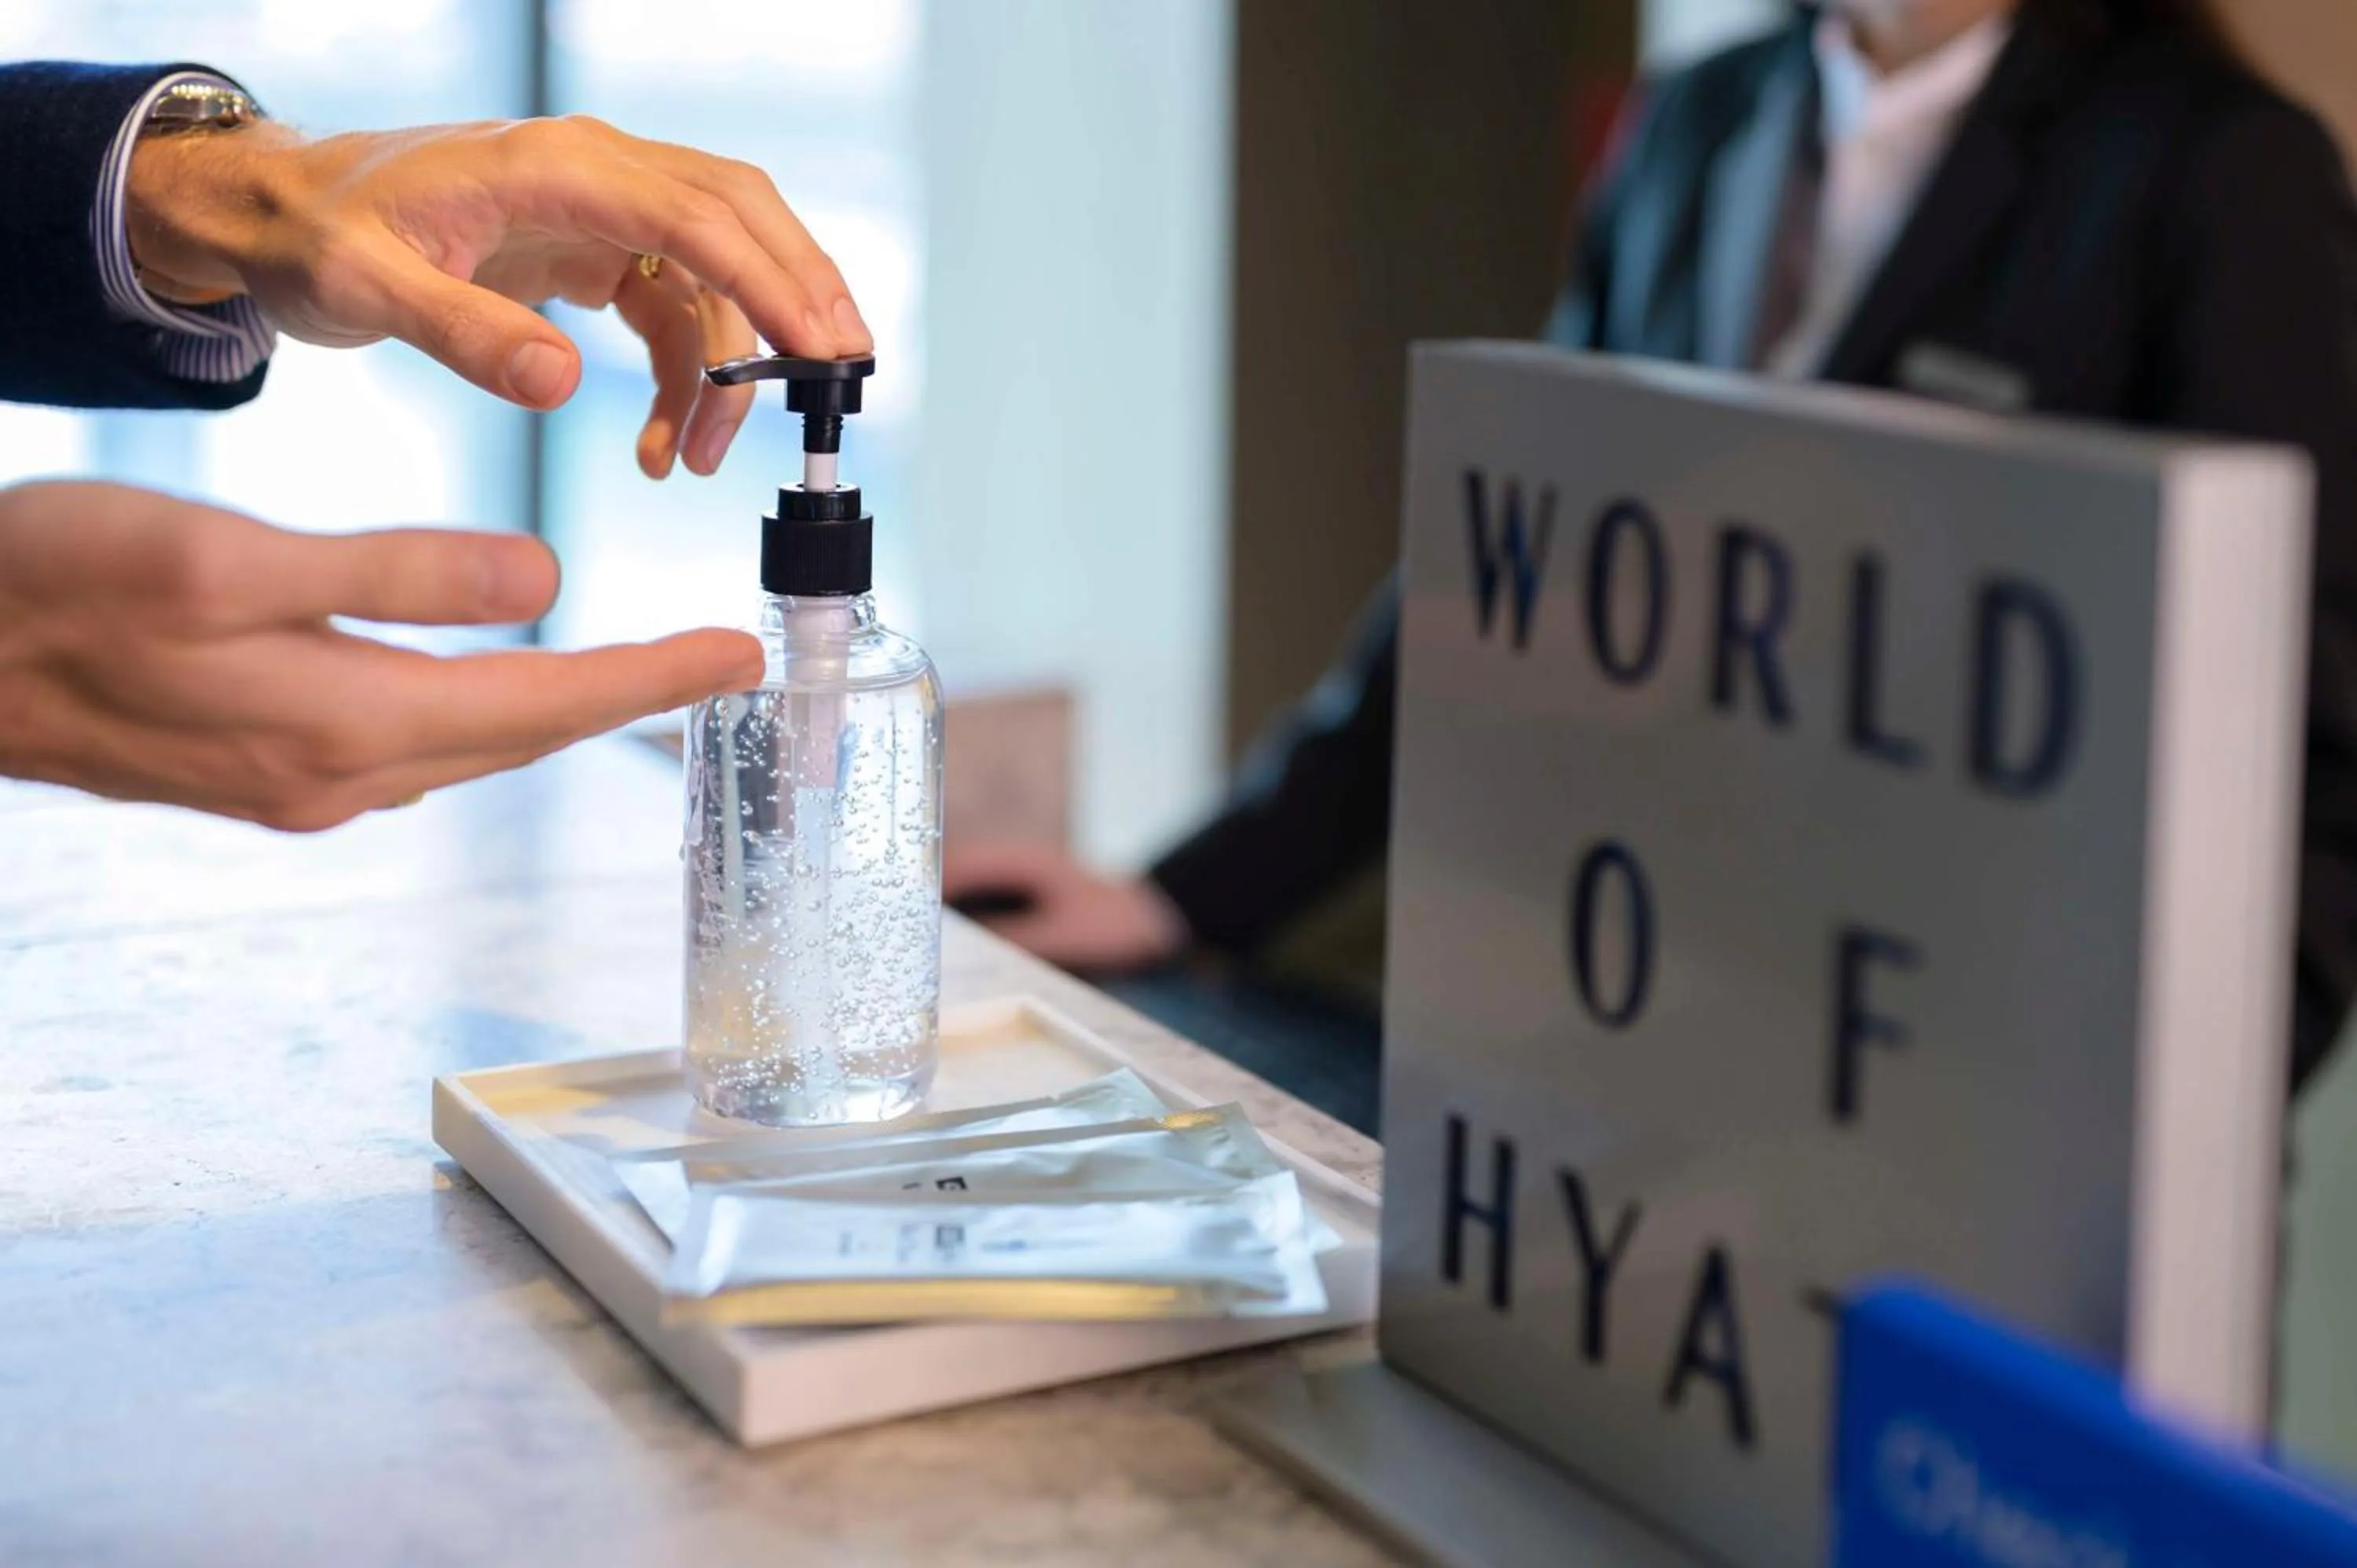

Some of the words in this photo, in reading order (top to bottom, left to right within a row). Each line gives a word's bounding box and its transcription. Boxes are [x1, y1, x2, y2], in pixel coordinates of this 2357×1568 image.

[1463, 467, 2084, 800] WORLD
[1566, 837, 1919, 1129] OF
[1439, 1110, 1835, 1449] HYA
